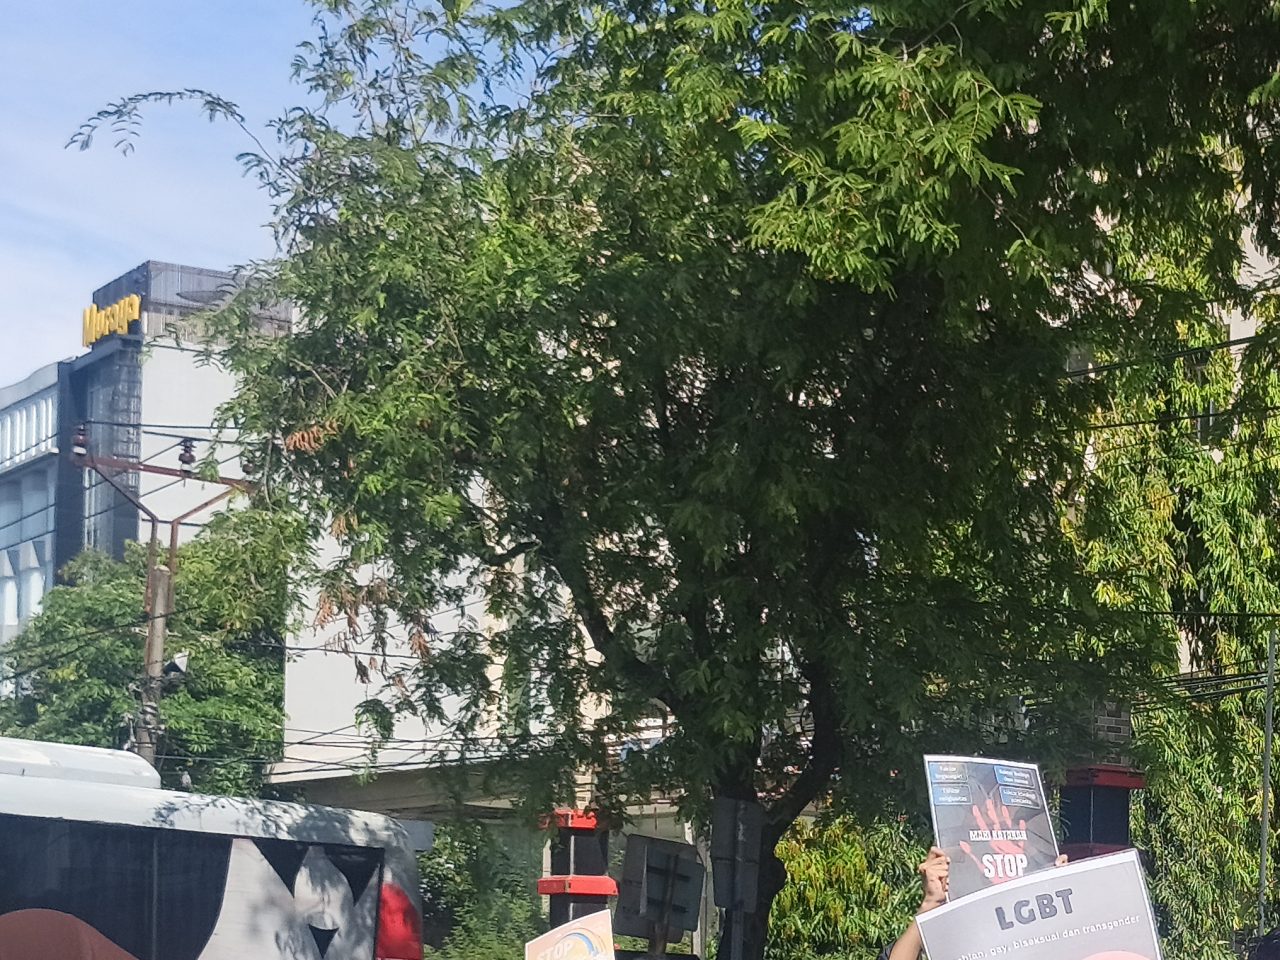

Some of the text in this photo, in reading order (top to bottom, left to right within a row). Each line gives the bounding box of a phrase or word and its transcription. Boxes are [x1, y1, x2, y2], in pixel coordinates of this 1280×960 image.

[981, 852, 1029, 879] STOP
[994, 888, 1074, 930] LGBT
[990, 943, 1012, 957] gay,
[1062, 927, 1081, 939] dan
[1082, 915, 1141, 934] transgender
